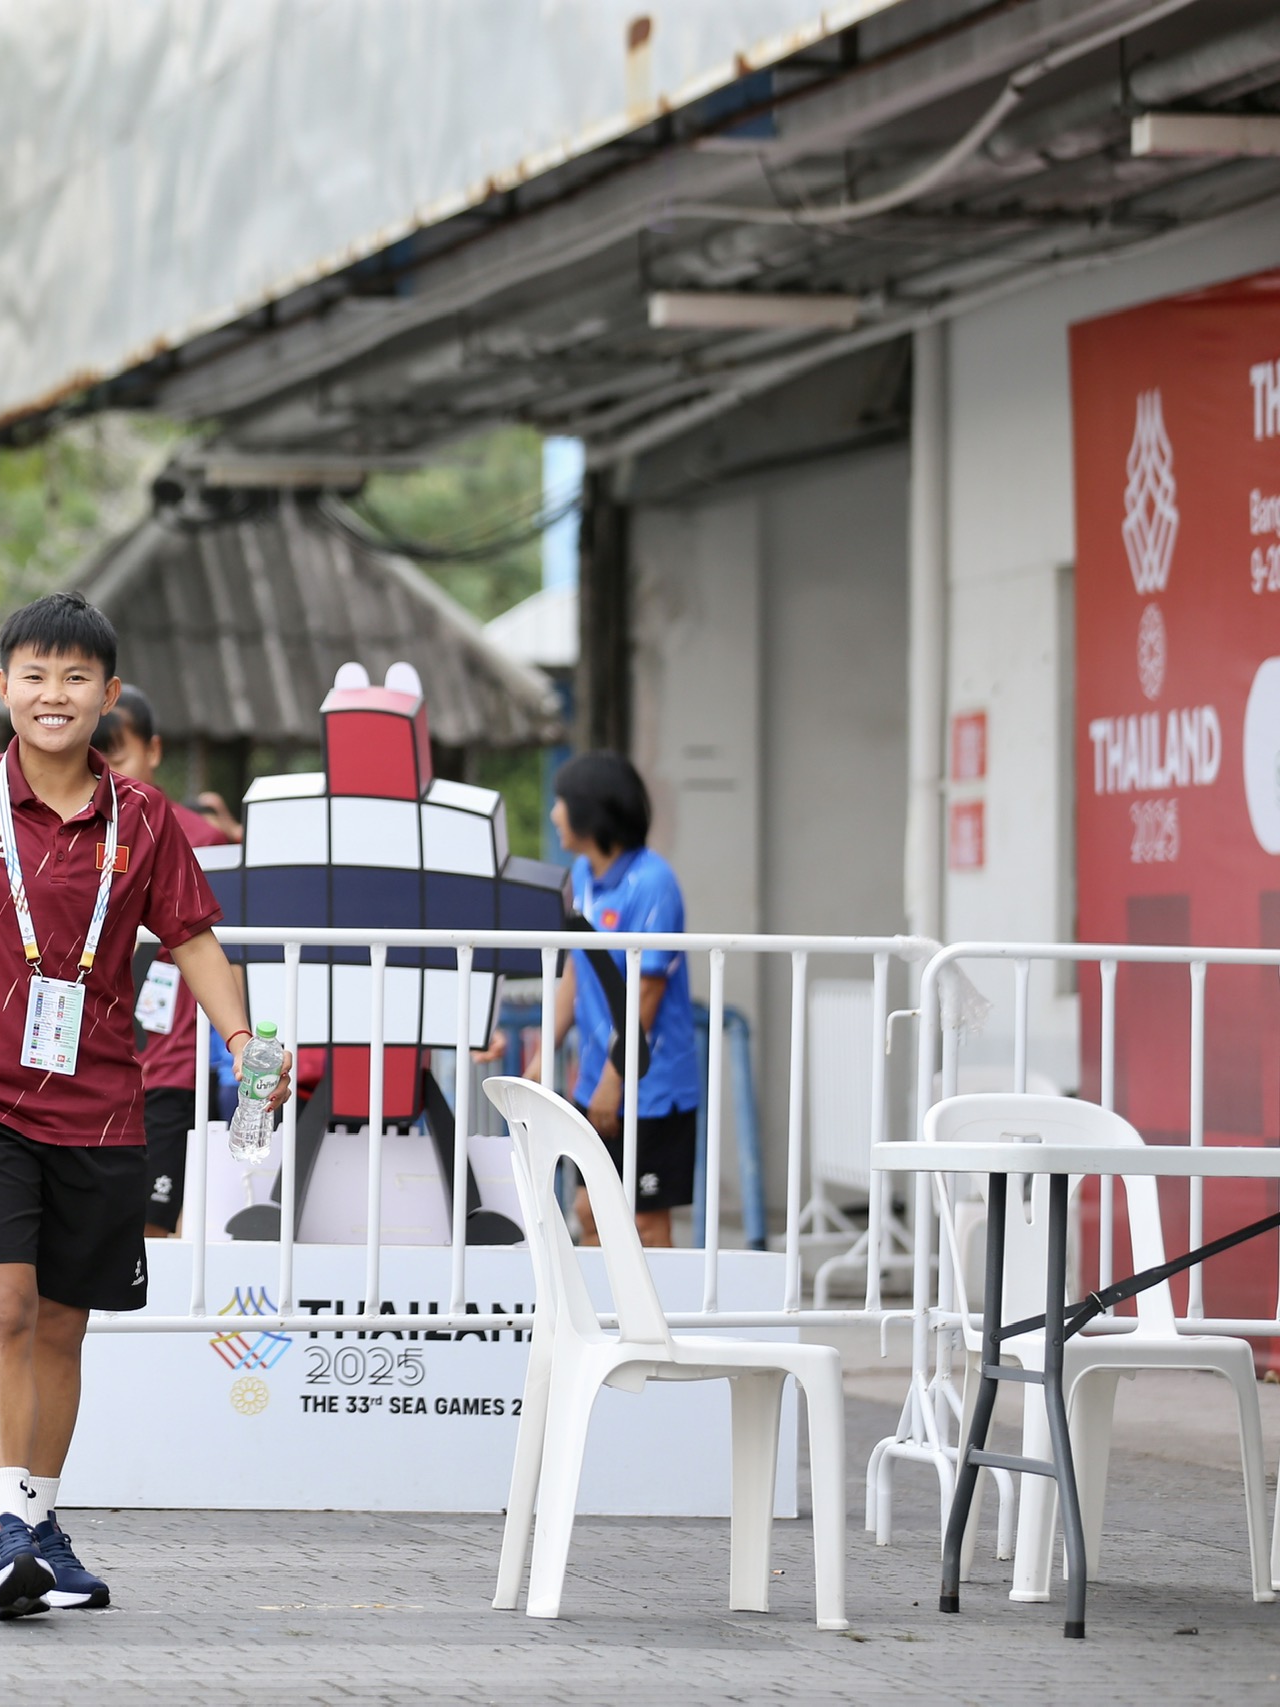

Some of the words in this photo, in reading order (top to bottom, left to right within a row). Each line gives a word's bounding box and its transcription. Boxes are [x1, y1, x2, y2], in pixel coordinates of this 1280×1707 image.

[1089, 705, 1221, 795] THAILAND
[1130, 798, 1180, 863] 2025
[299, 1300, 536, 1342] THAILAN
[304, 1345, 426, 1387] 2025
[300, 1395, 339, 1413] THE
[345, 1395, 383, 1413] 33rd
[389, 1396, 428, 1414] SEA
[434, 1397, 505, 1416] GAMES
[511, 1398, 523, 1416] 2
